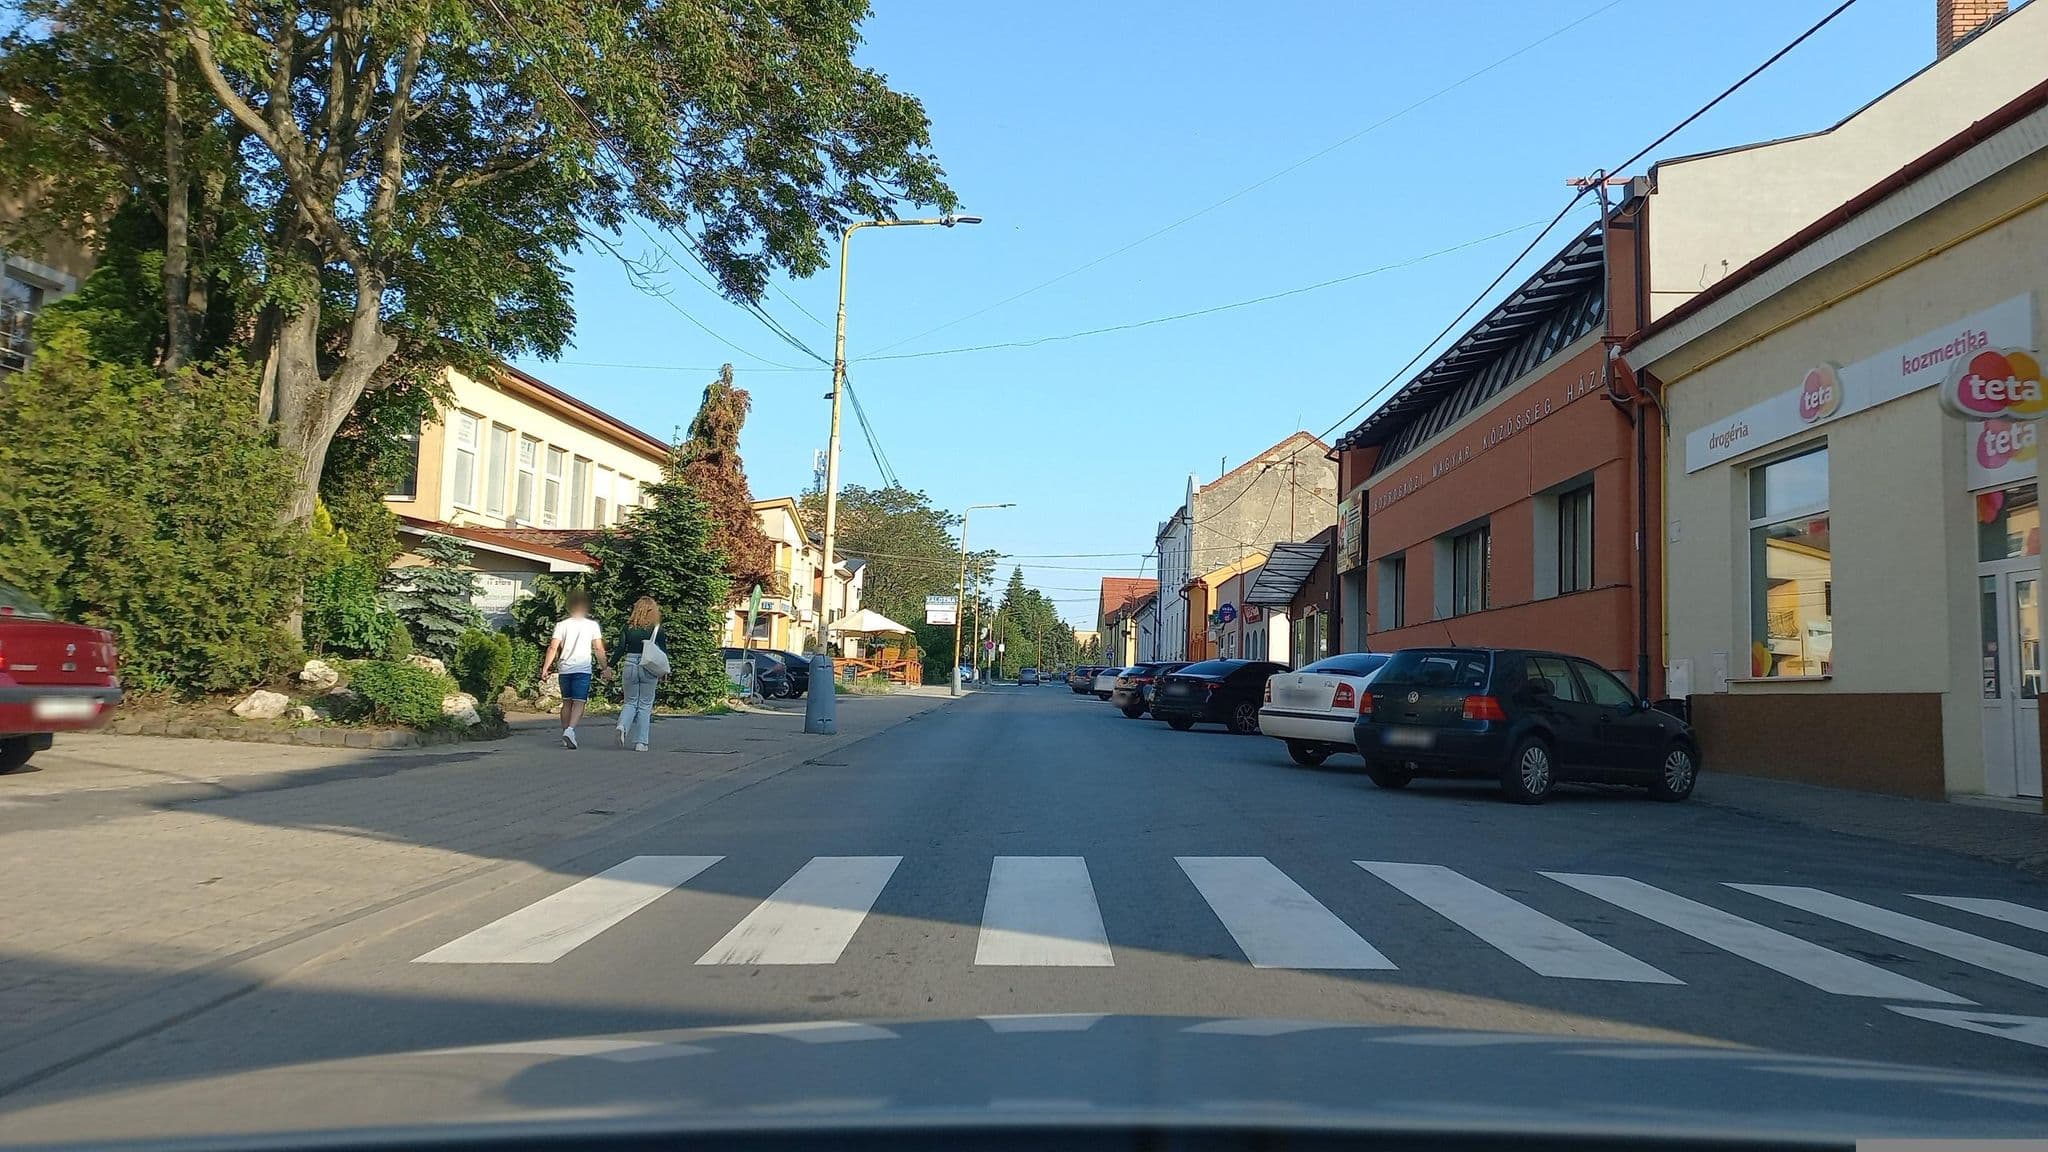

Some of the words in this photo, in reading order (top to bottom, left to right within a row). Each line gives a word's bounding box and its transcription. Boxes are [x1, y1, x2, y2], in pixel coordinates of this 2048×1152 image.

[1902, 329, 1988, 377] kozmetika
[1803, 386, 1833, 410] teta
[1970, 374, 2043, 401] teta
[1482, 398, 1551, 450] KÖZÖSSÉG
[1709, 421, 1749, 450] drogéria
[1984, 422, 2037, 457] teta
